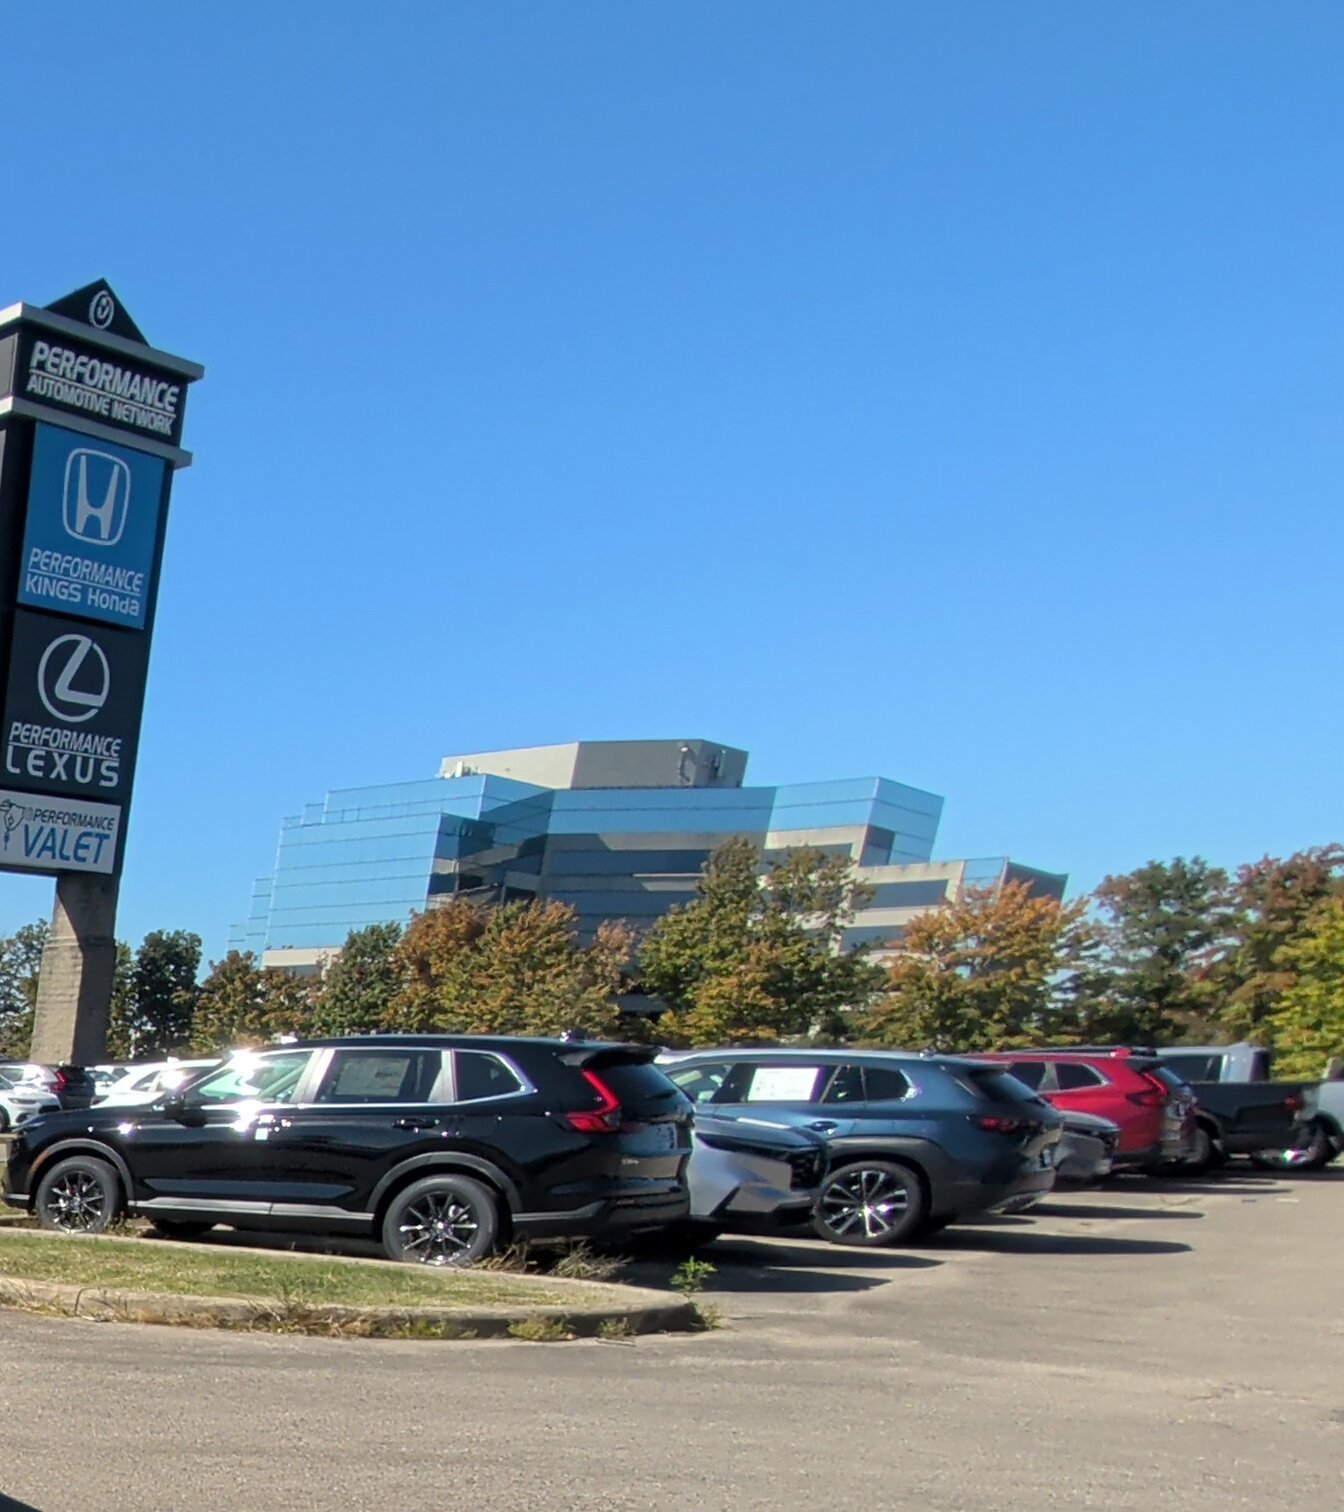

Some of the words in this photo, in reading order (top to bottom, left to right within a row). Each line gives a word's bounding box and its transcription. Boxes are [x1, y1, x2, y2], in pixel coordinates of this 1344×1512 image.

[30, 340, 180, 412] PERFORMANCE
[26, 376, 110, 416] AUTOMOTIVE
[112, 401, 175, 435] NETWORK
[28, 547, 144, 592] PERFORMANCE
[25, 574, 81, 603] KINGS
[87, 590, 140, 617] Honda
[10, 722, 122, 758] PERFORMANCE
[6, 746, 120, 788] LEXUS
[33, 808, 115, 831] PERFORMANCE
[24, 823, 111, 864] VALET
